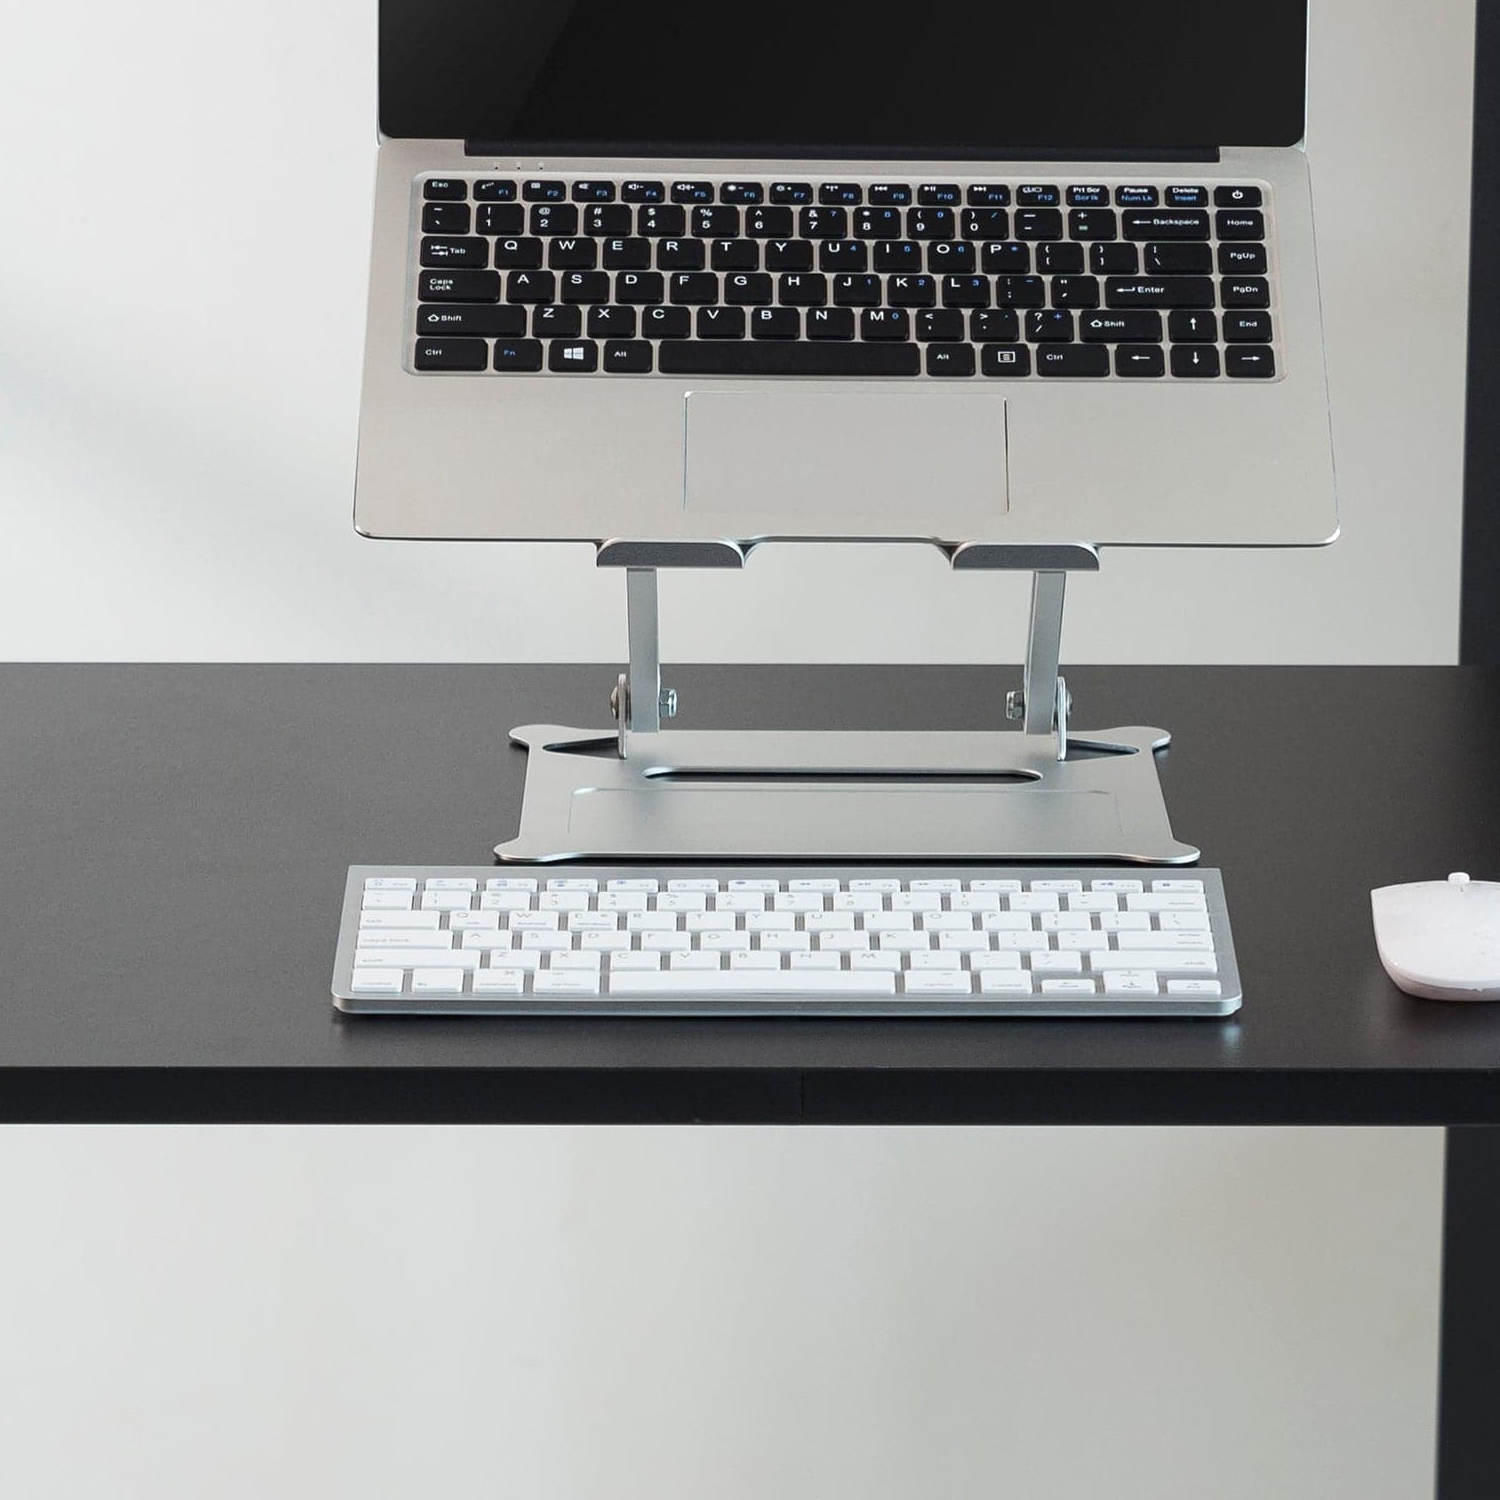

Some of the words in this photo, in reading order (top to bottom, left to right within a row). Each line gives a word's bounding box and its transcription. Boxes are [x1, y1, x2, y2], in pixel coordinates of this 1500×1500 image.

[431, 181, 449, 189] Esc
[1072, 186, 1086, 194] Prt
[1153, 218, 1200, 226] Backspace
[504, 240, 518, 251] Q
[558, 240, 576, 250] W
[611, 240, 623, 251] E
[666, 240, 679, 252] R
[720, 241, 733, 252] T
[775, 242, 788, 252] Y
[828, 242, 841, 253] U
[885, 243, 890, 254] I
[936, 243, 951, 254] O
[990, 244, 1002, 254] P
[1230, 252, 1256, 260] PgUp
[429, 278, 454, 287] Caps
[517, 273, 530, 284] A
[570, 274, 583, 285] S
[625, 274, 638, 285] D
[679, 275, 690, 286] F
[733, 275, 748, 286] G
[787, 275, 800, 286] H
[842, 276, 852, 287] J
[896, 277, 908, 288] K
[950, 277, 961, 288] L
[429, 283, 451, 291] Lock
[1137, 285, 1165, 294] Enter
[1232, 285, 1259, 294] PgDn
[440, 314, 462, 322] Shift
[542, 307, 555, 318] Z
[598, 308, 610, 319] X
[652, 308, 665, 319] C
[706, 309, 720, 320] V
[760, 309, 773, 320] B
[815, 310, 828, 320] N
[870, 310, 885, 321] M
[424, 348, 442, 356] Ctrl
[1046, 353, 1064, 361] Ctrl
